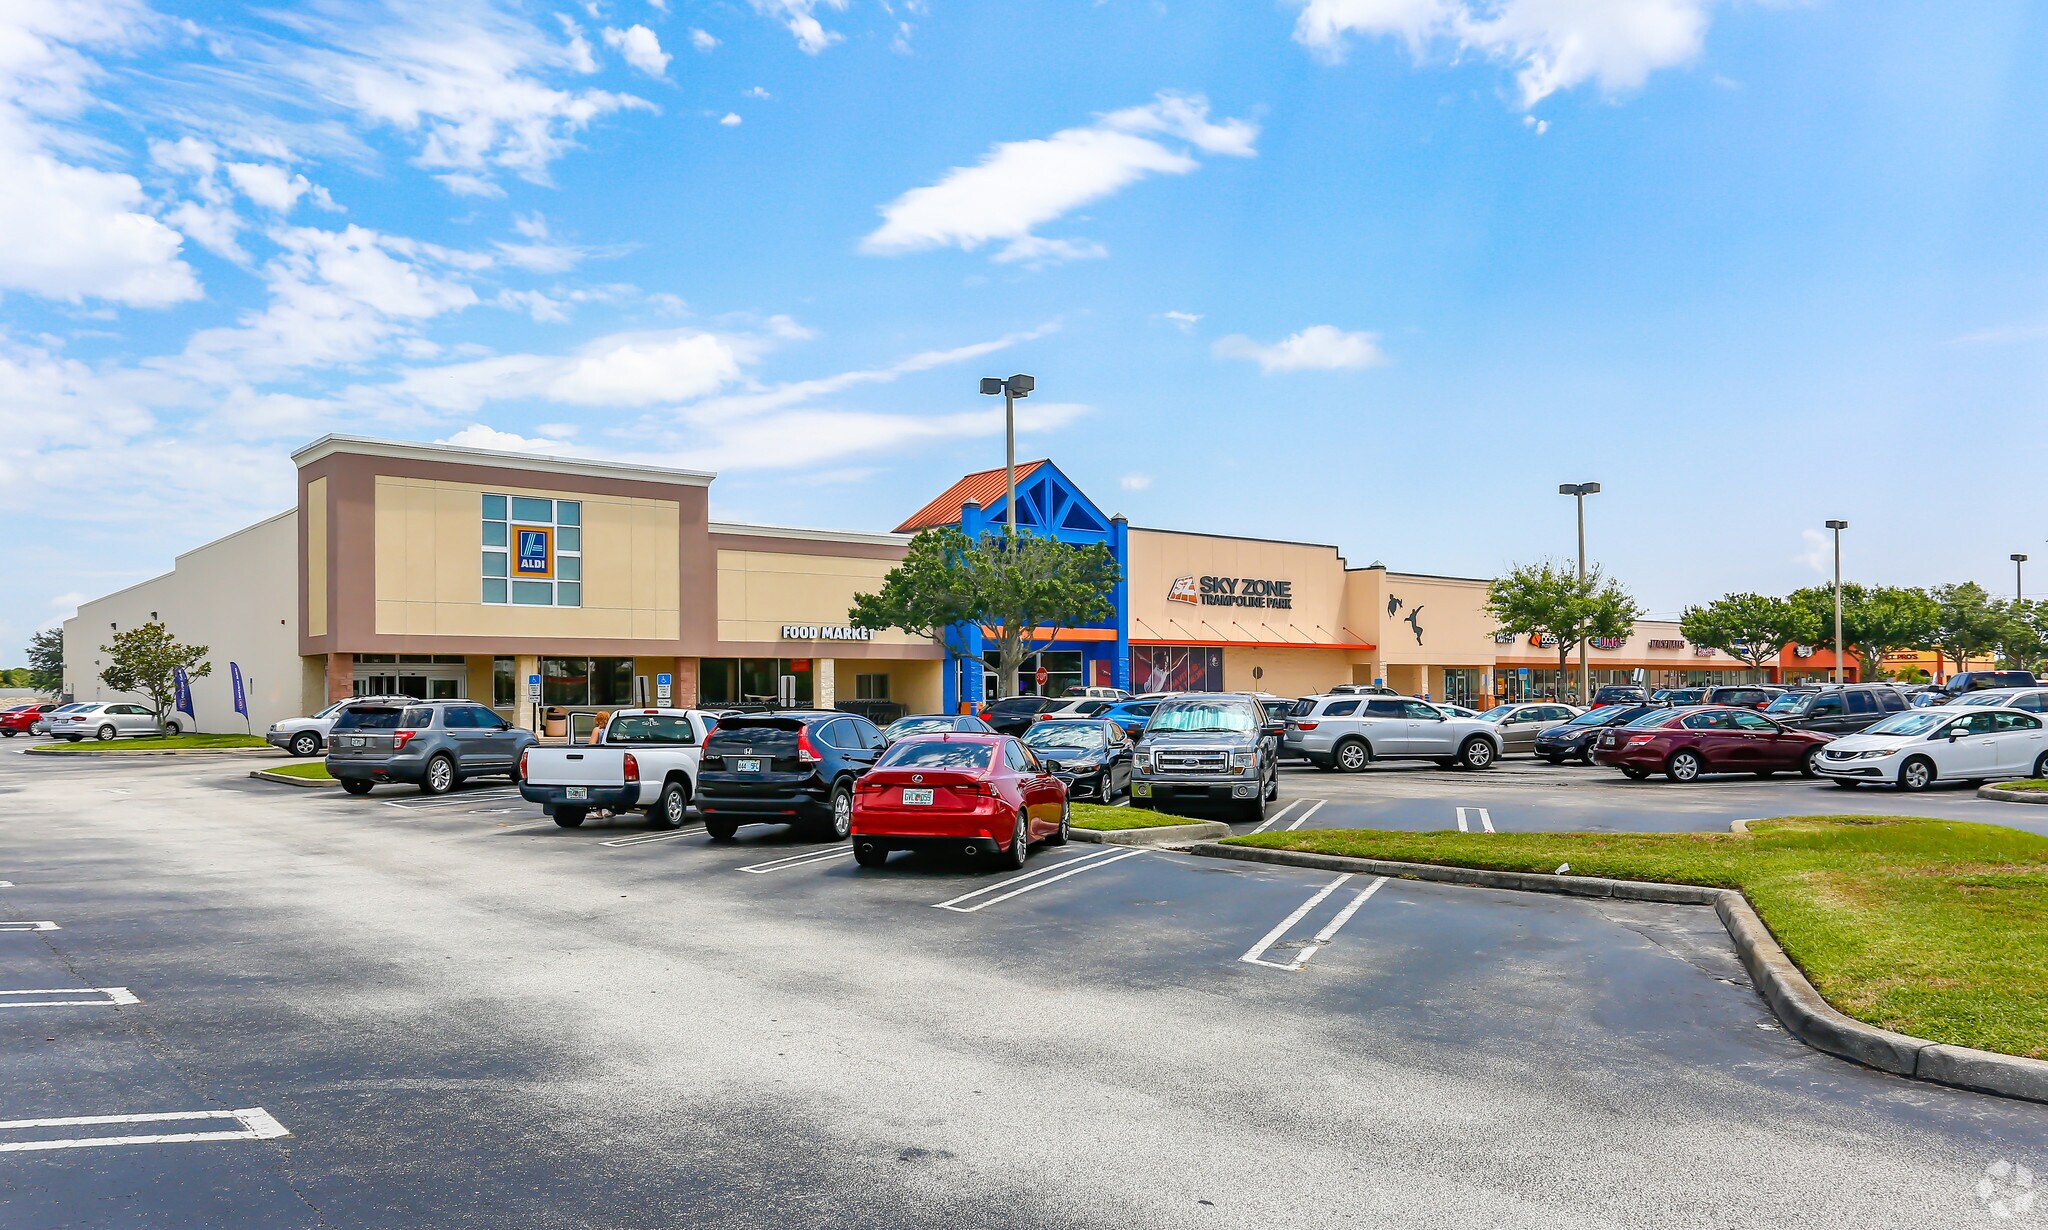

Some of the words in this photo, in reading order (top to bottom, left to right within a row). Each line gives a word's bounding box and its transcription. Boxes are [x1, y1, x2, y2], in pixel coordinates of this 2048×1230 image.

[521, 559, 545, 569] ALDI
[1199, 575, 1239, 594] SKY
[1241, 578, 1292, 597] ZONE
[1199, 593, 1266, 608] TRAMPOLINE
[1266, 597, 1292, 609] PARK
[782, 626, 818, 639] FOOD
[820, 627, 875, 640] MARKET
